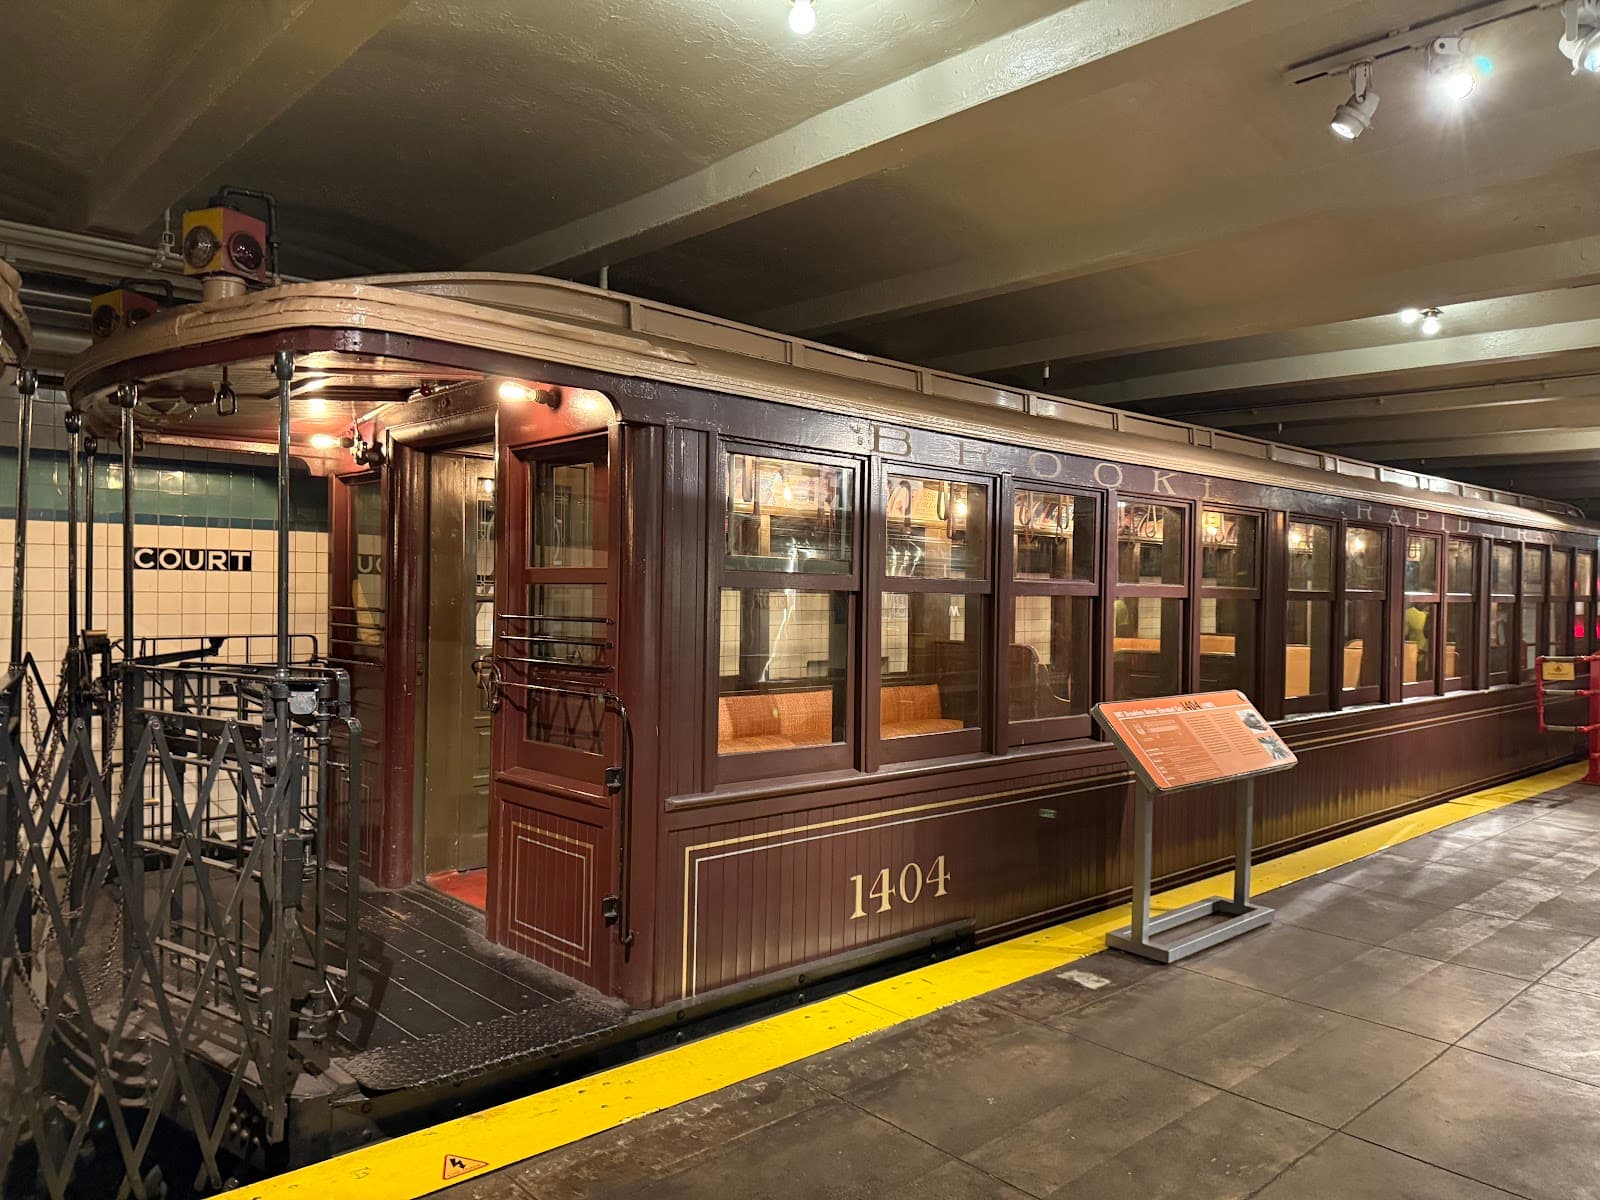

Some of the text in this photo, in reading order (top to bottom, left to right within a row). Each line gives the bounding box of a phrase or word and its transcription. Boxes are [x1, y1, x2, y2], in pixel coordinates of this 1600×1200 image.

[872, 423, 1295, 512] BROOKL
[1357, 504, 1471, 533] RAPID
[134, 548, 251, 571] COURT
[849, 855, 951, 919] 1404
